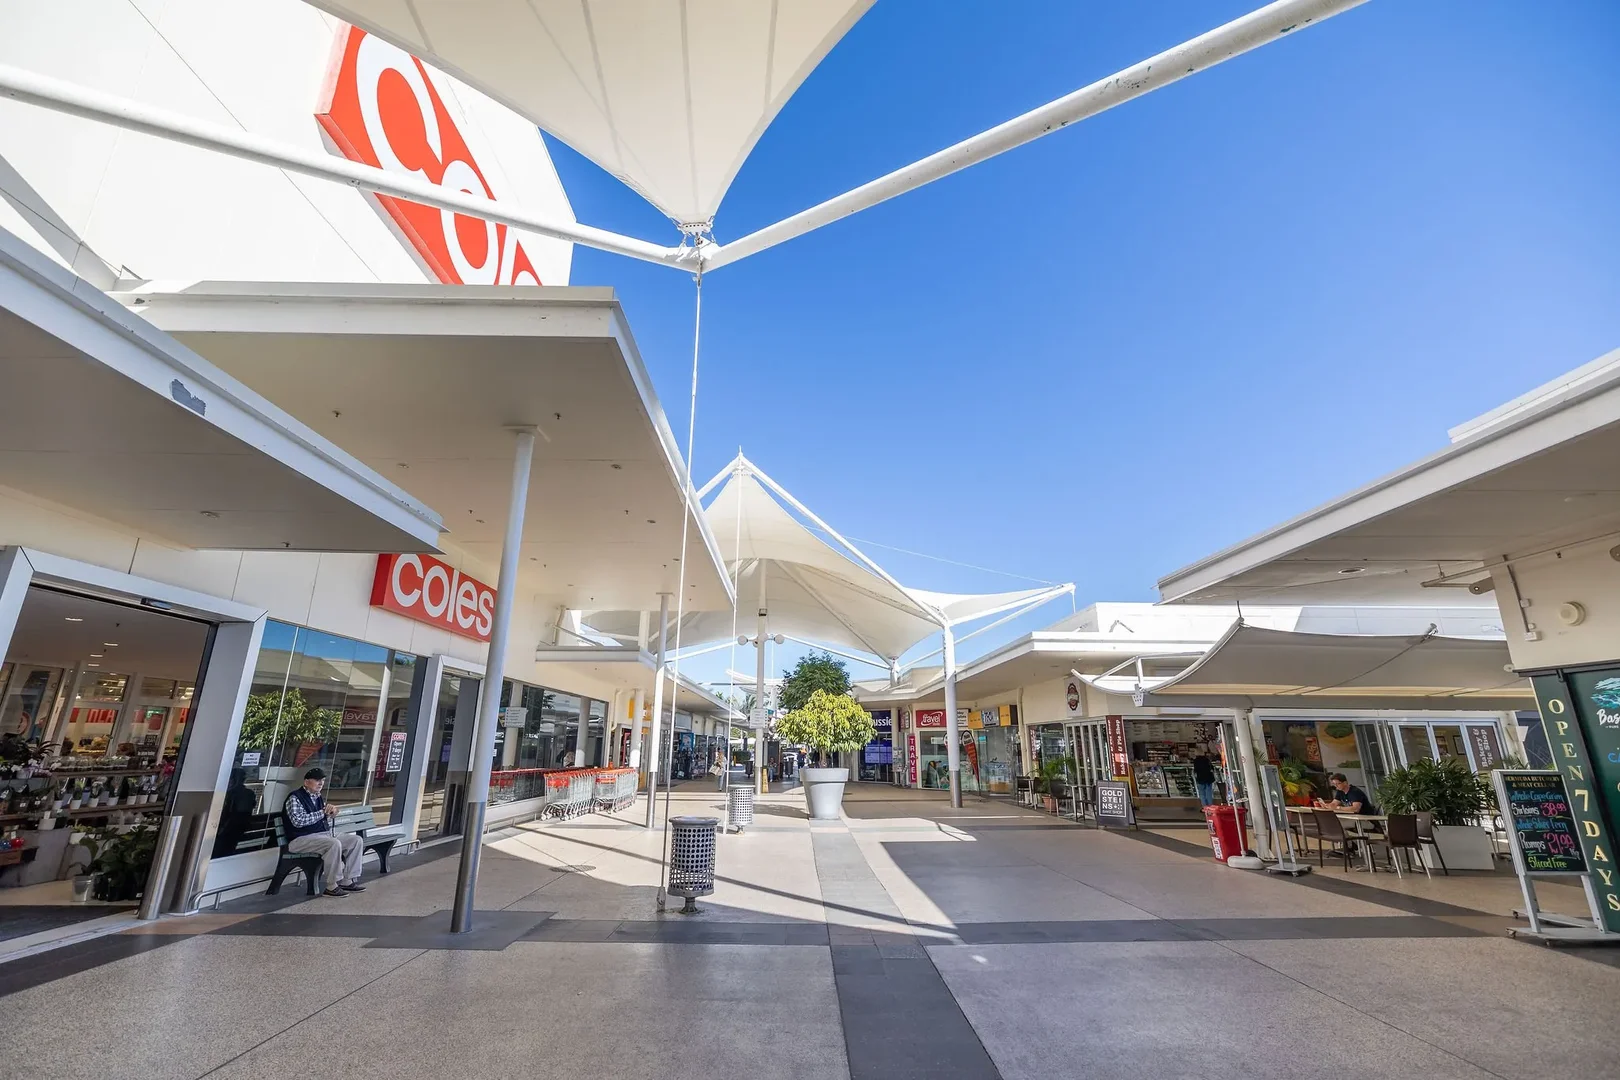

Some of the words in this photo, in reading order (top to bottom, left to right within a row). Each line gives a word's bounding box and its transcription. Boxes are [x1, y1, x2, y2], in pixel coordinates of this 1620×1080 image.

[872, 716, 892, 726] ussie
[1596, 708, 1620, 726] Bas
[1480, 729, 1491, 751] Shop
[909, 738, 917, 781] TRAVEL
[1475, 736, 1489, 768] Bakery
[1101, 789, 1123, 797] GOLD
[1548, 698, 1584, 781] OPEN
[1575, 789, 1589, 812] 7
[1582, 820, 1620, 911] DAYS
